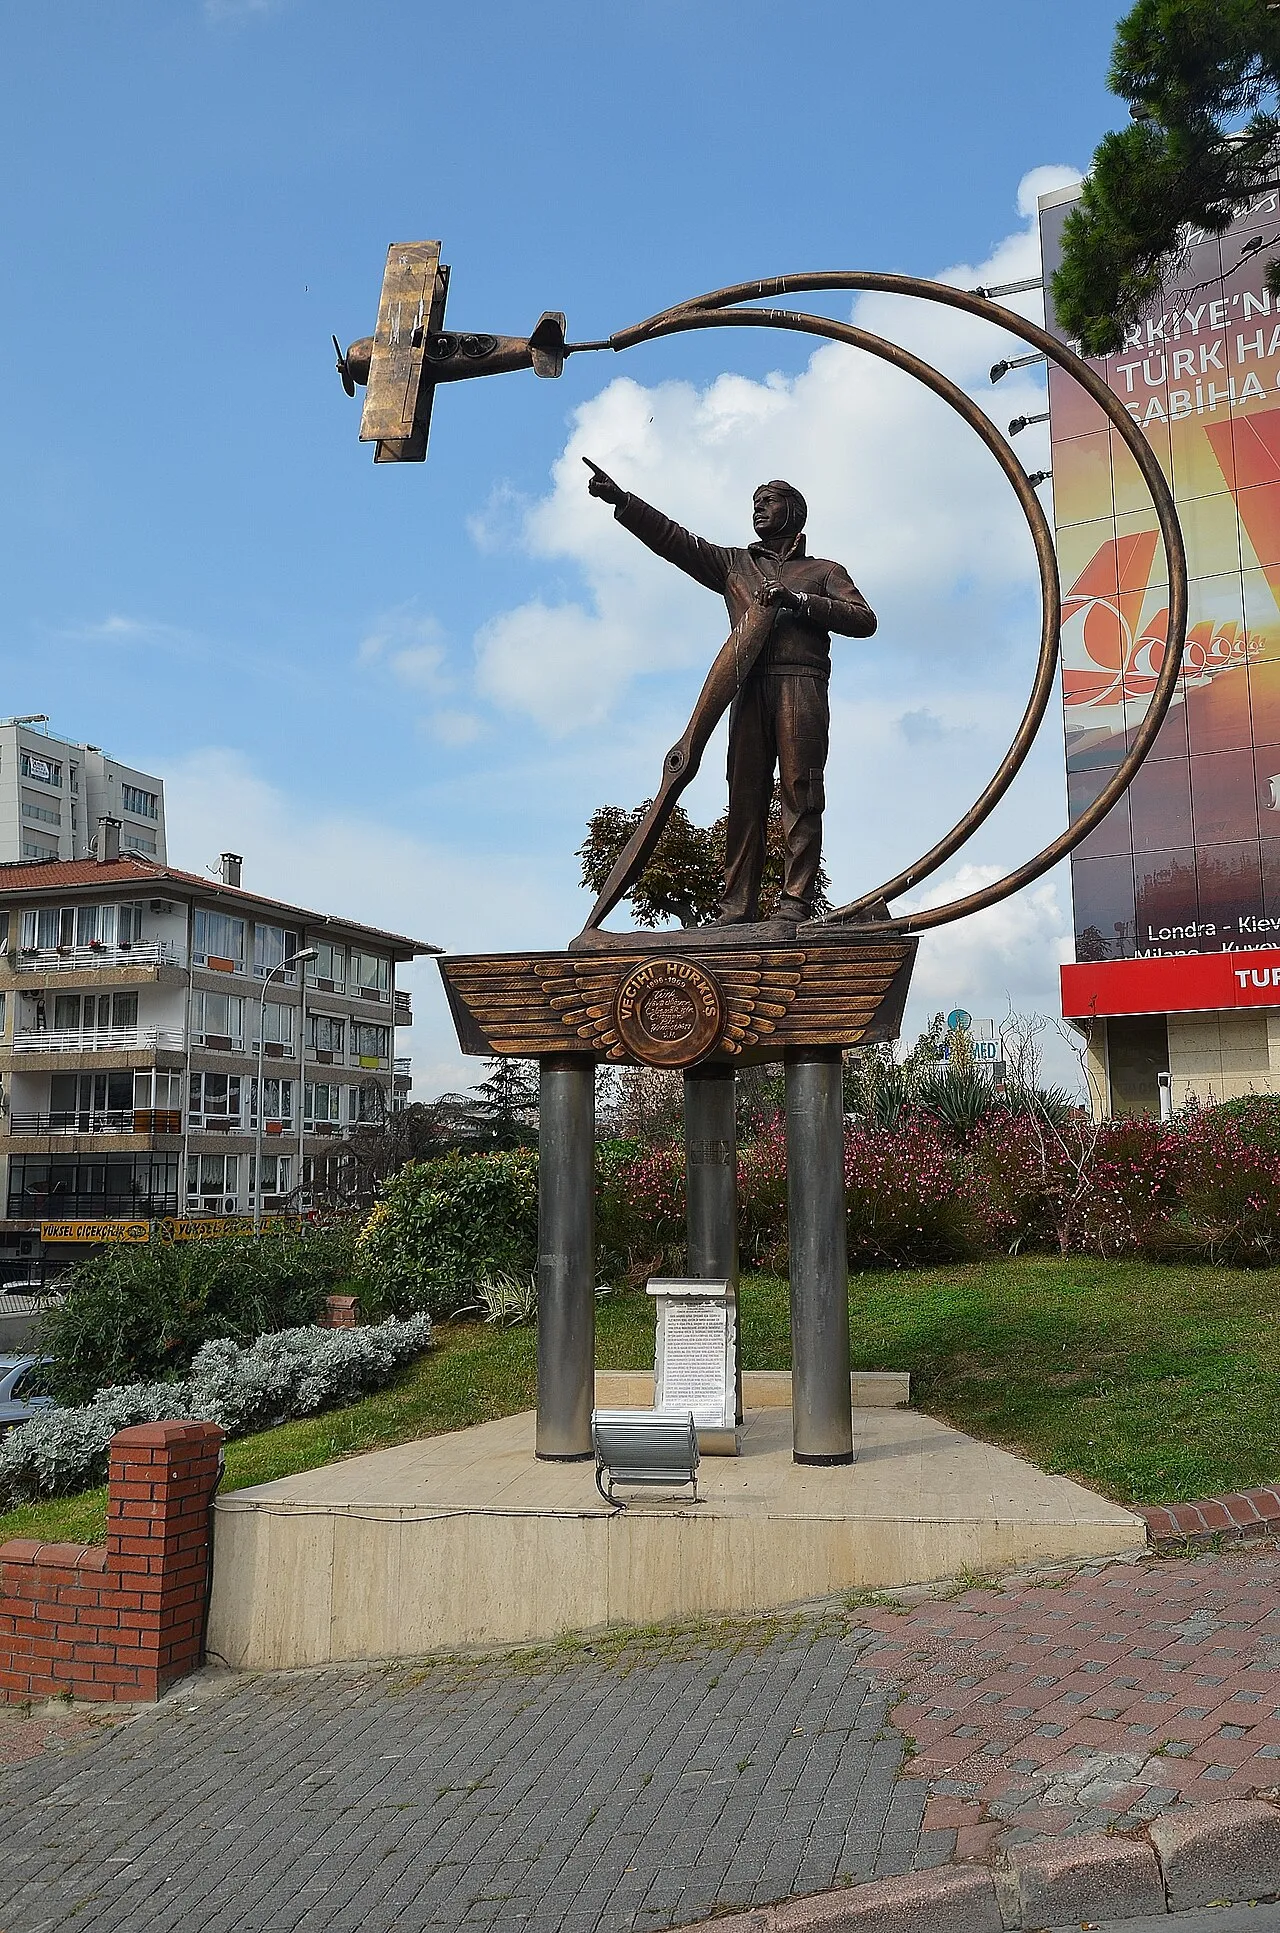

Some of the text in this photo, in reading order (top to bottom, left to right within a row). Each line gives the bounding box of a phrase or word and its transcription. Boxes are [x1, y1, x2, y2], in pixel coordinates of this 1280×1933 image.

[1116, 339, 1225, 393] TÜRK
[1123, 372, 1267, 429] SABİHA
[1147, 921, 1216, 941] Londra
[43, 1224, 74, 1237] YÜKSEL
